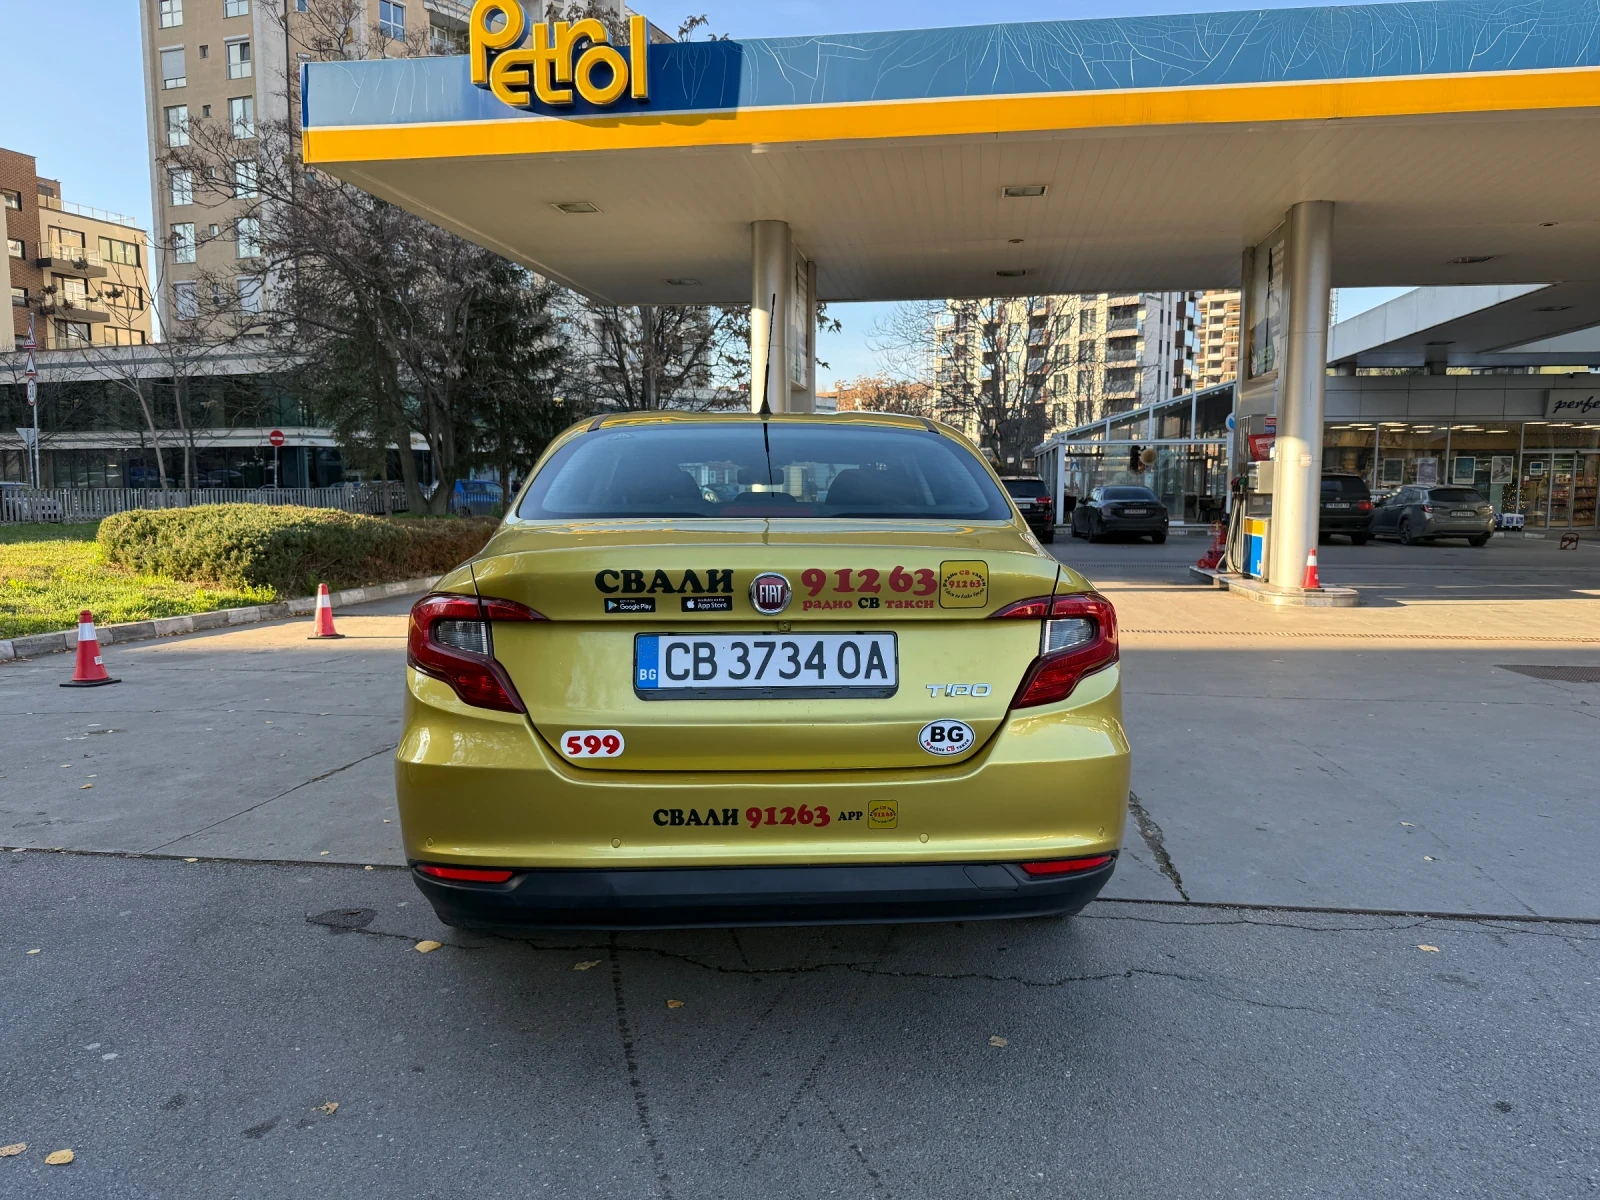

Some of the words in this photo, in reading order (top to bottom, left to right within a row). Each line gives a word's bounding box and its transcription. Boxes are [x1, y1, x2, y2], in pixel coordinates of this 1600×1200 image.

[469, 0, 648, 106] Petrol
[595, 569, 734, 594] СВАЛИ
[800, 565, 938, 597] 91263
[948, 580, 982, 588] 91263
[759, 584, 784, 603] FIAT
[620, 603, 640, 611] Google
[640, 603, 652, 611] Play
[697, 602, 710, 610] App
[802, 599, 853, 611] радио
[858, 597, 880, 609] СВ
[884, 599, 935, 609] такси
[666, 642, 718, 681] CB
[728, 641, 827, 680] 3734
[837, 641, 889, 680] OA
[639, 669, 657, 681] BG
[926, 683, 992, 698] TIPO
[930, 726, 964, 743] BG
[566, 734, 621, 756] 599
[652, 808, 739, 827] СВАЛИ
[745, 803, 831, 829] 91263
[837, 811, 863, 821] APP
